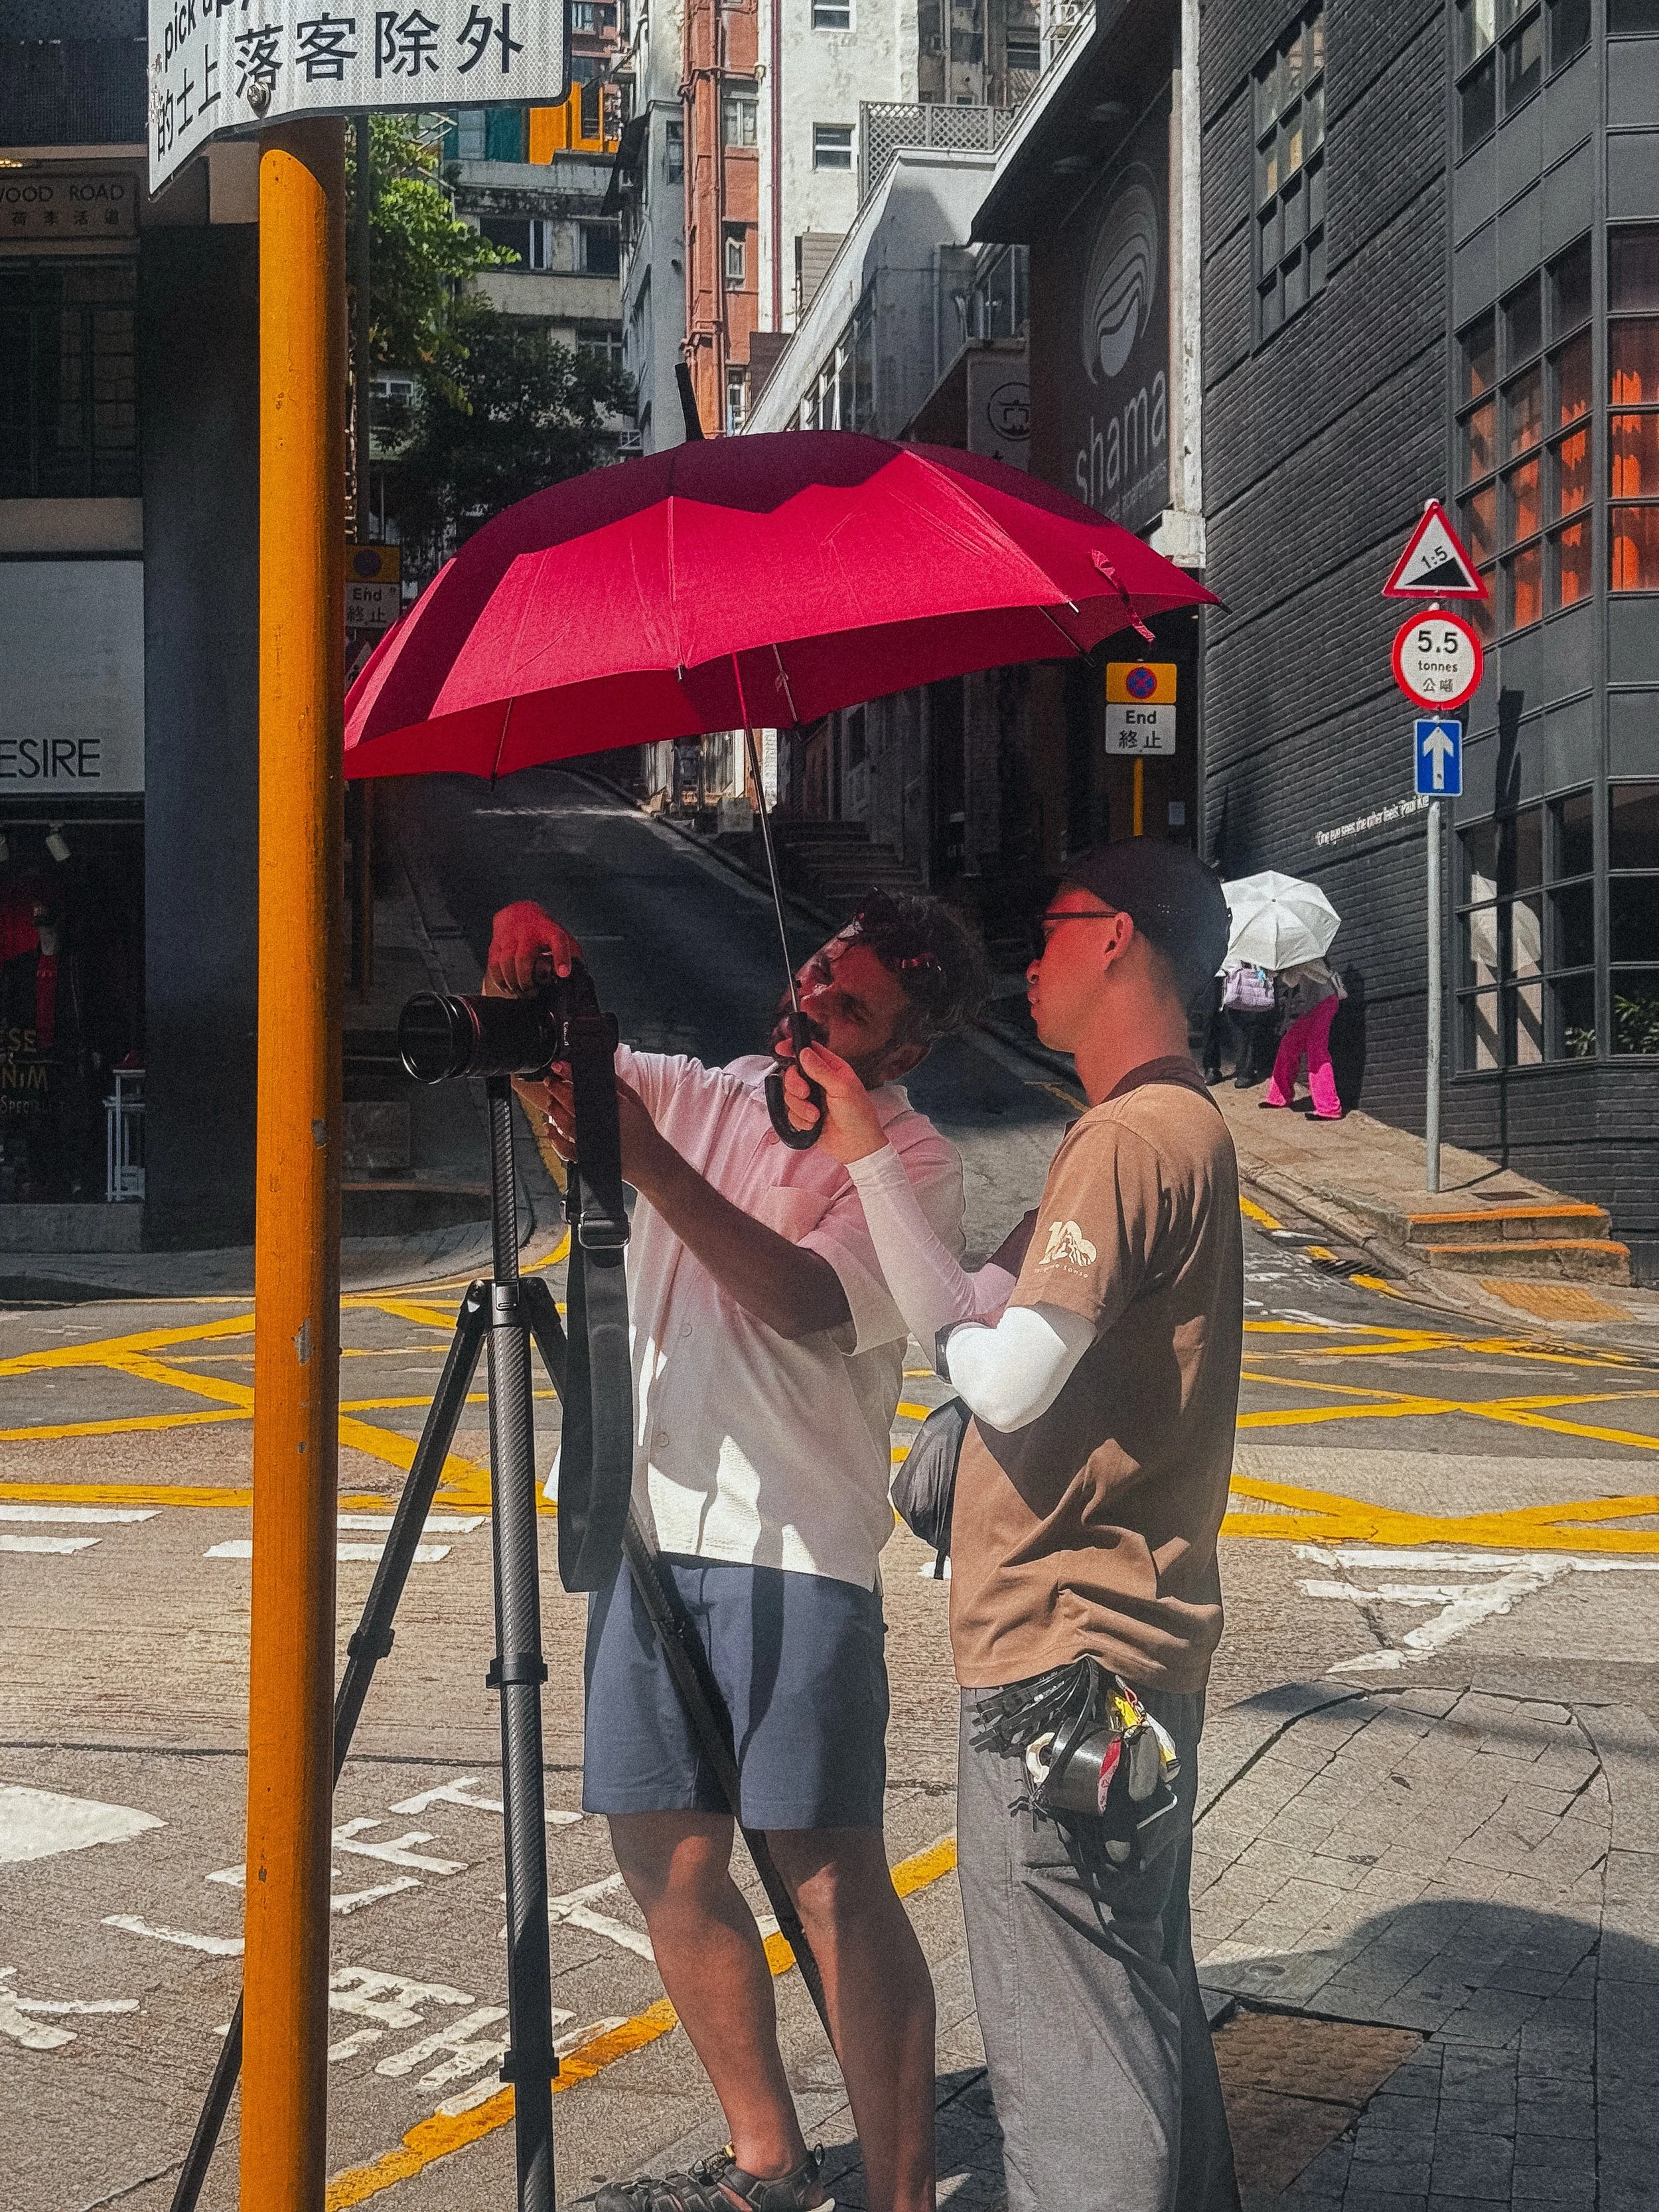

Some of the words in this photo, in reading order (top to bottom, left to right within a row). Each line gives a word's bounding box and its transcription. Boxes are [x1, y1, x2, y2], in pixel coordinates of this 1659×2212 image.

[165, 0, 197, 73] pick
[69, 184, 125, 202] ROAD
[1076, 370, 1166, 506] shama
[1421, 545, 1449, 570] 1:5
[352, 587, 382, 601] End
[1417, 630, 1459, 654] 5.5
[1417, 660, 1459, 674] tonnes
[1125, 710, 1157, 725] End
[1118, 729, 1163, 749] 終止
